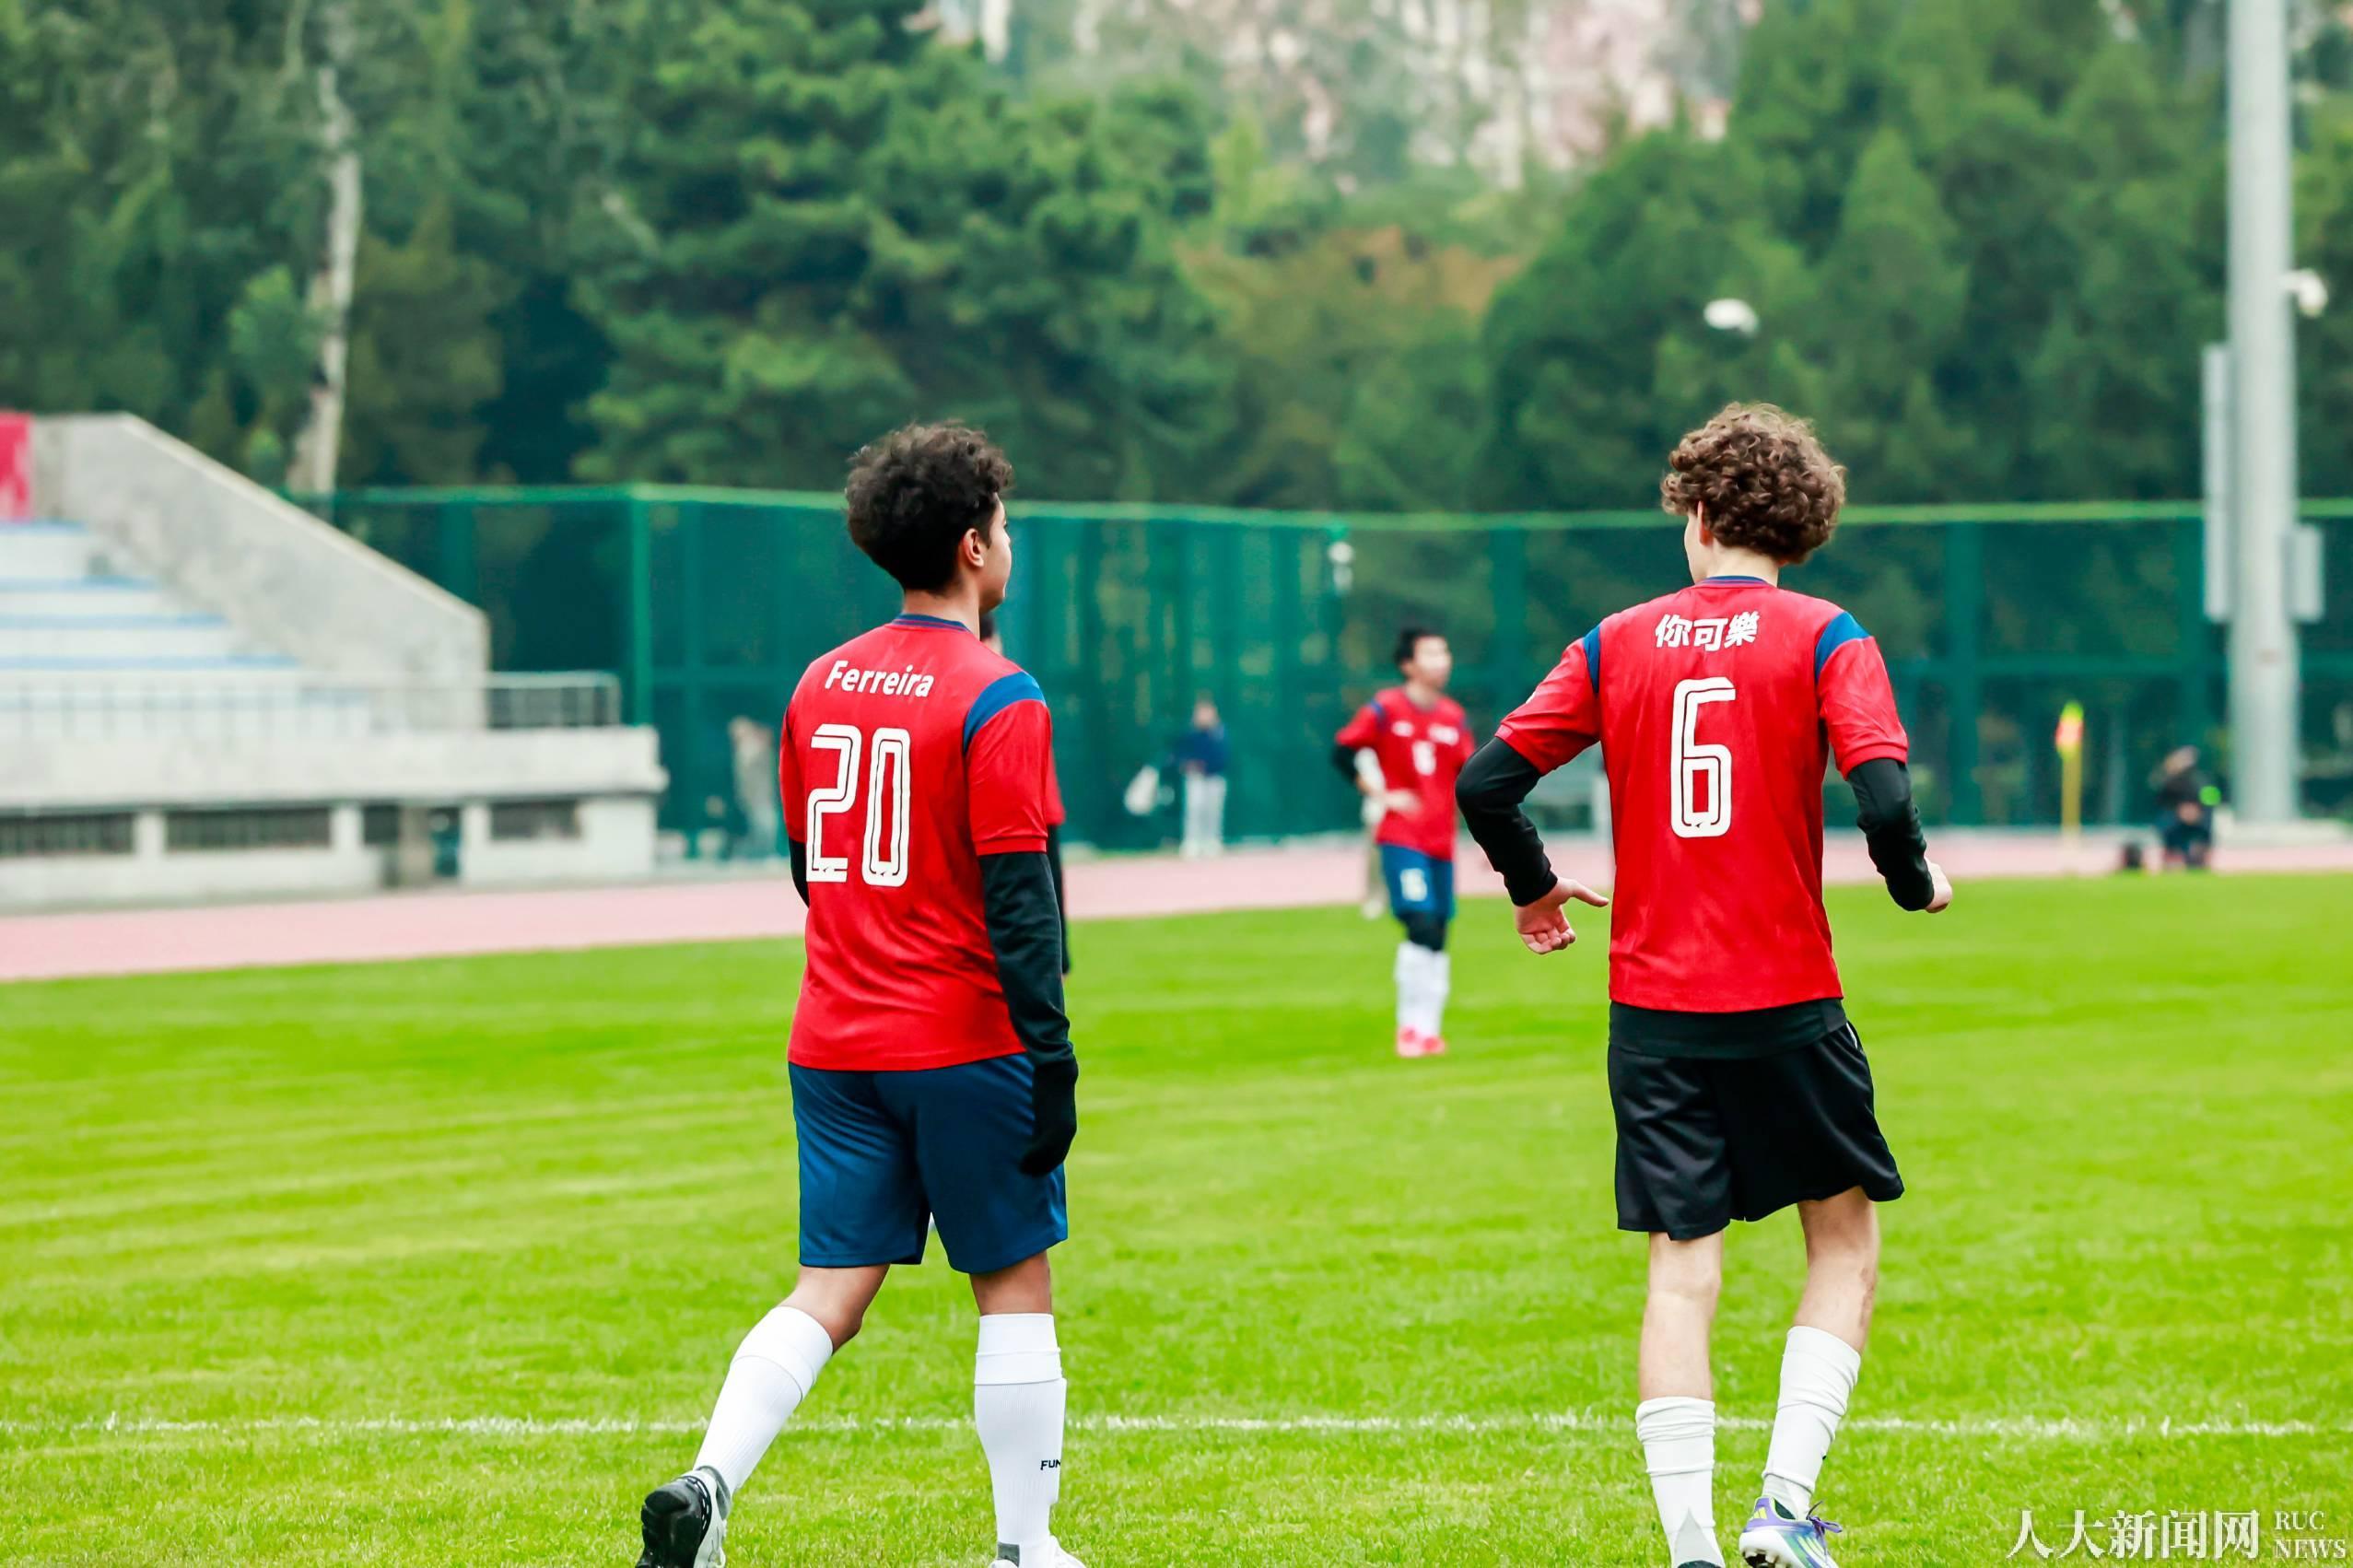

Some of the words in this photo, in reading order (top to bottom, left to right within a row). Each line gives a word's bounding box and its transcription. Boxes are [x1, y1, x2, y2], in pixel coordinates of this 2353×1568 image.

[825, 660, 934, 697] Ferreira
[1655, 611, 1760, 651] 你可樂
[806, 723, 911, 887] 20
[1671, 677, 1736, 838] 6
